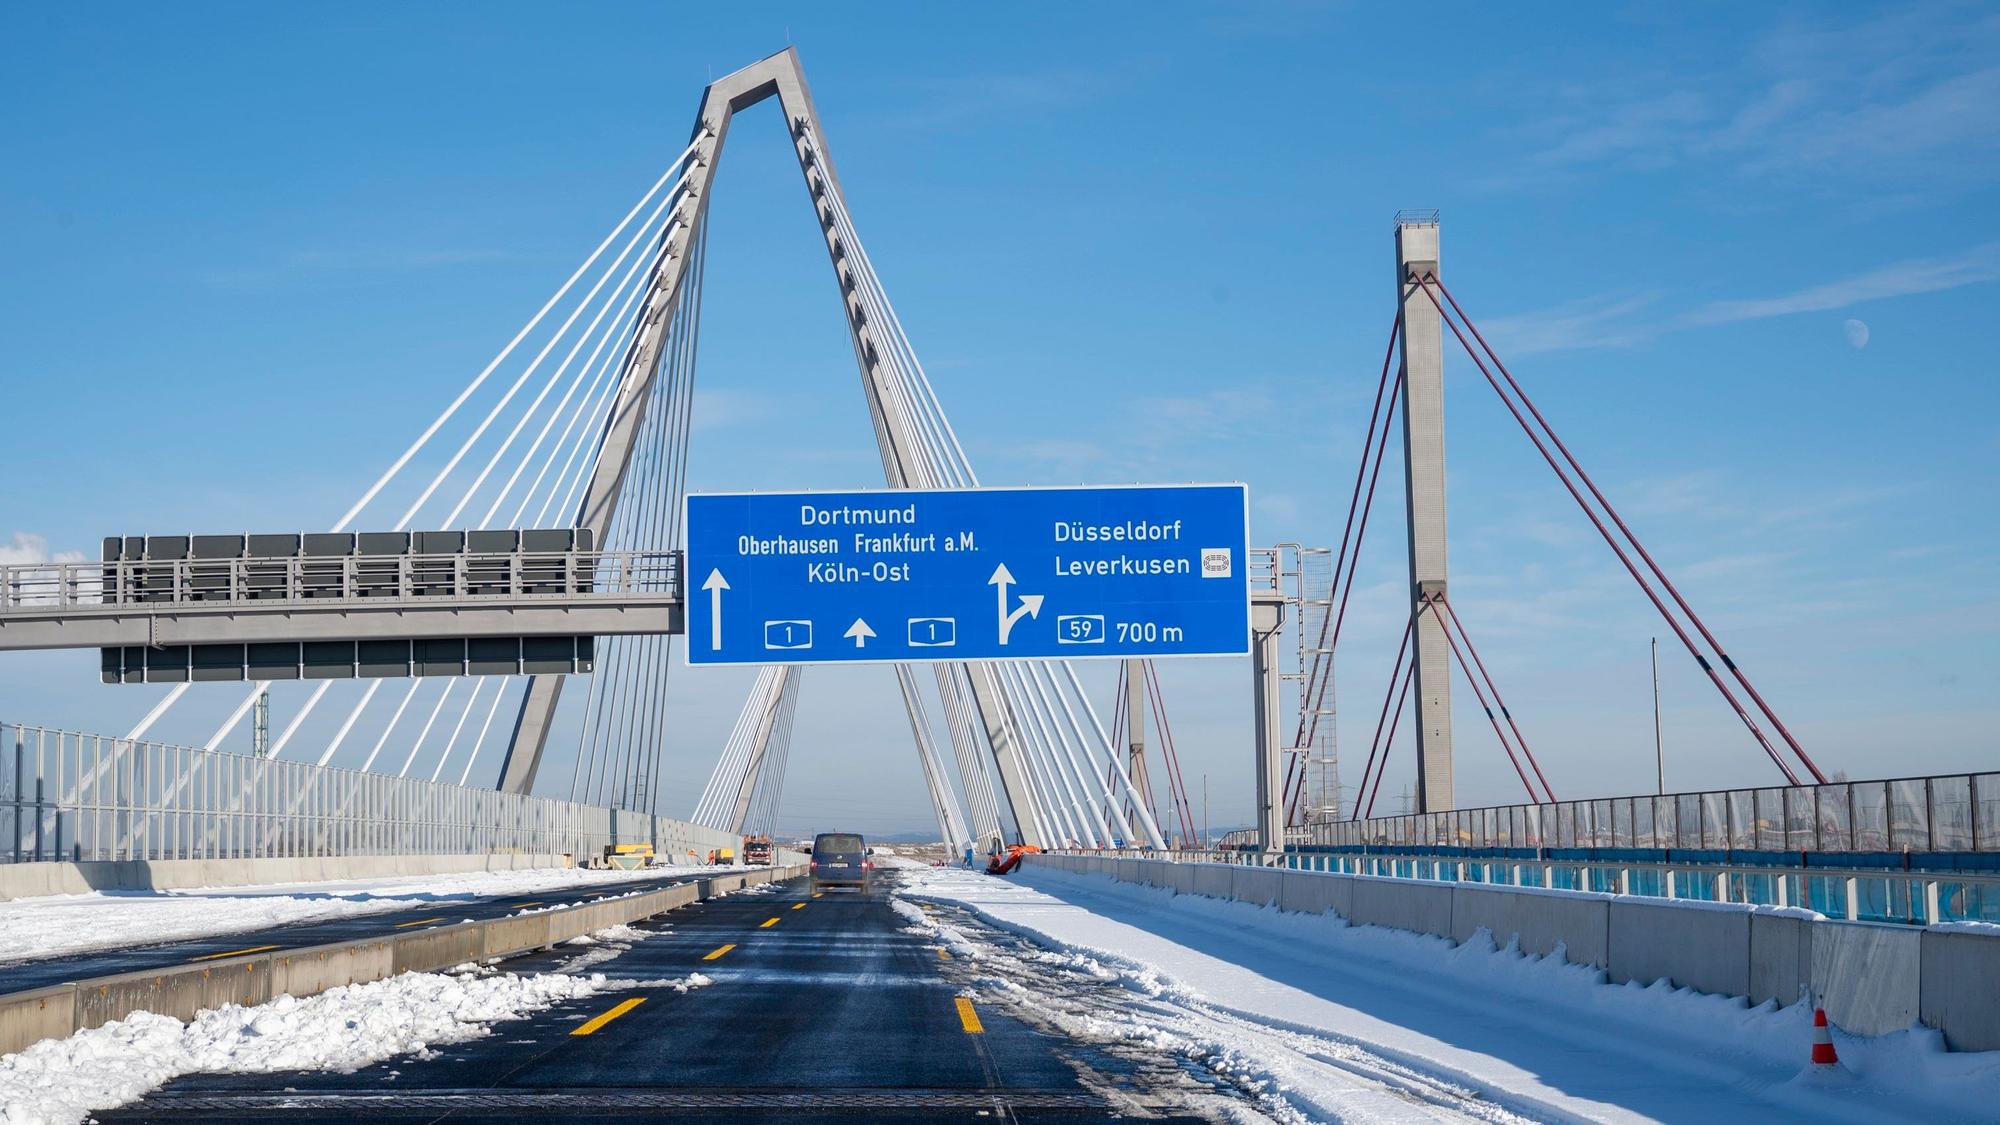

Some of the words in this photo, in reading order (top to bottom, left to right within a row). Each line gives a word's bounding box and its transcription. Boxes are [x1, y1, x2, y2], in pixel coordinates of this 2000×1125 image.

[802, 504, 915, 526] Dortmund
[1055, 520, 1181, 542] Düsseldorf
[738, 535, 839, 556] Oberhausen
[856, 533, 936, 553] Frankfurt
[945, 532, 978, 552] a.M.
[809, 562, 910, 583] Köln-Ost
[1055, 555, 1190, 576] Leverkusen
[785, 626, 792, 643] 1
[928, 623, 936, 641] 1
[1069, 621, 1092, 639] 59
[1117, 623, 1157, 643] 700
[1163, 628, 1183, 642] m
